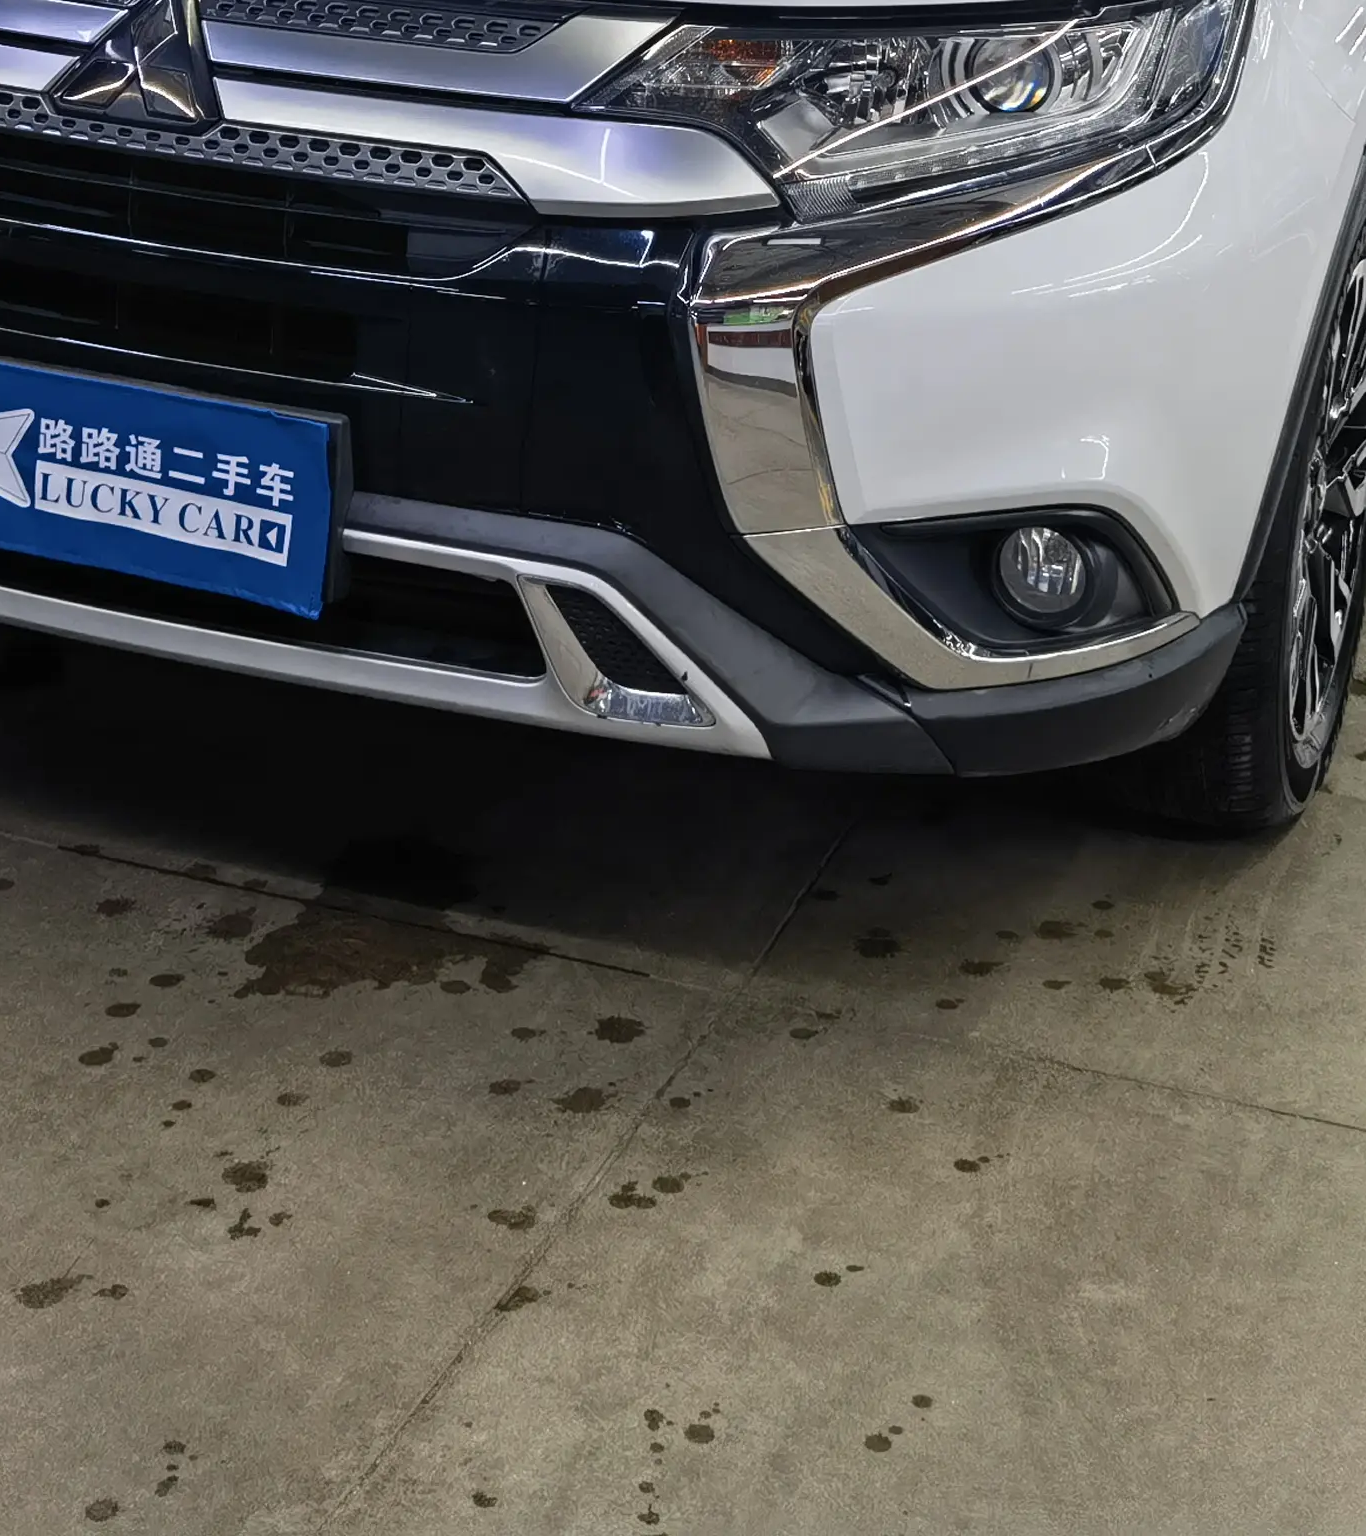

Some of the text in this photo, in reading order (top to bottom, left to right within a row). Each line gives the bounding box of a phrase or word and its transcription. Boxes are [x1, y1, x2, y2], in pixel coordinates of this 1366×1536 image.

[37, 417, 294, 507] 路路通二手车
[40, 471, 255, 547] LUCKY CAR
